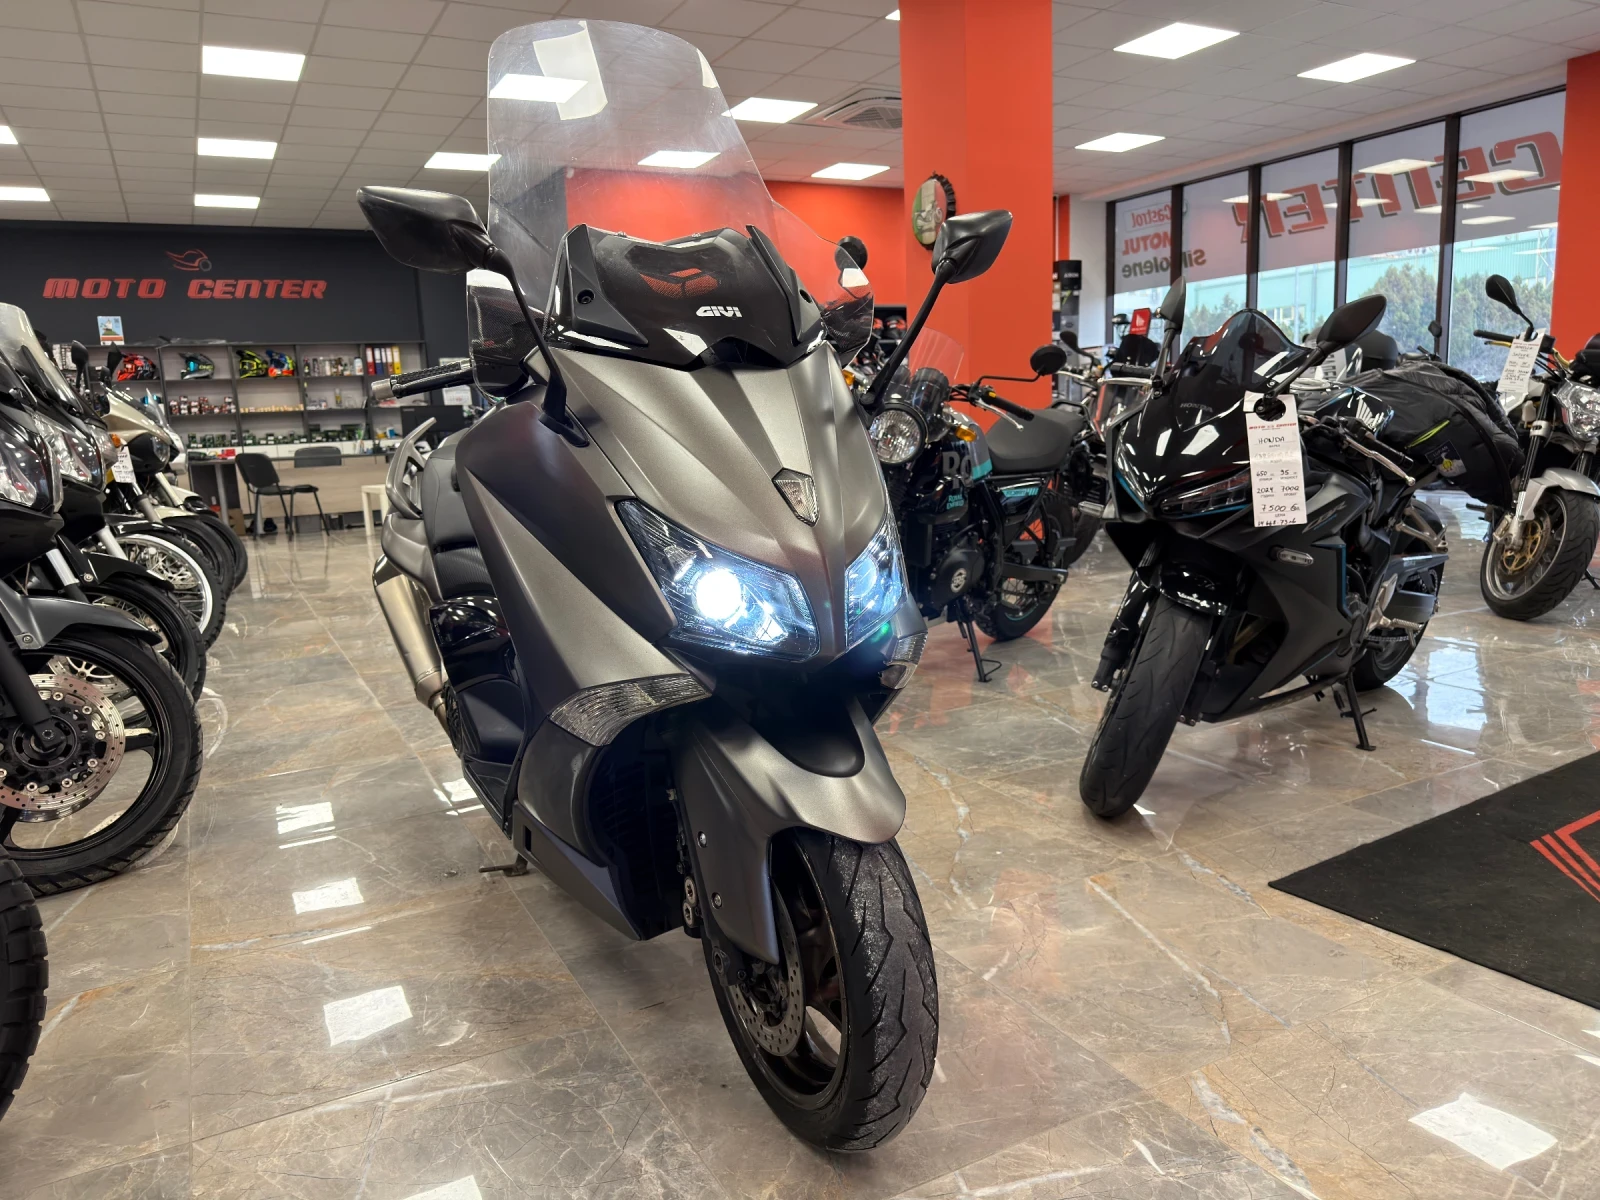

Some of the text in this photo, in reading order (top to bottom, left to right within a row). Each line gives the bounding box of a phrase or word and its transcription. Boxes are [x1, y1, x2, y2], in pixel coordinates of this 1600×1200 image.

[42, 278, 328, 299] MOTO CENTER
[695, 305, 743, 318] GIVI
[1180, 402, 1213, 413] HONDA
[1258, 436, 1285, 444] HONDA
[1256, 486, 1274, 494] 2024
